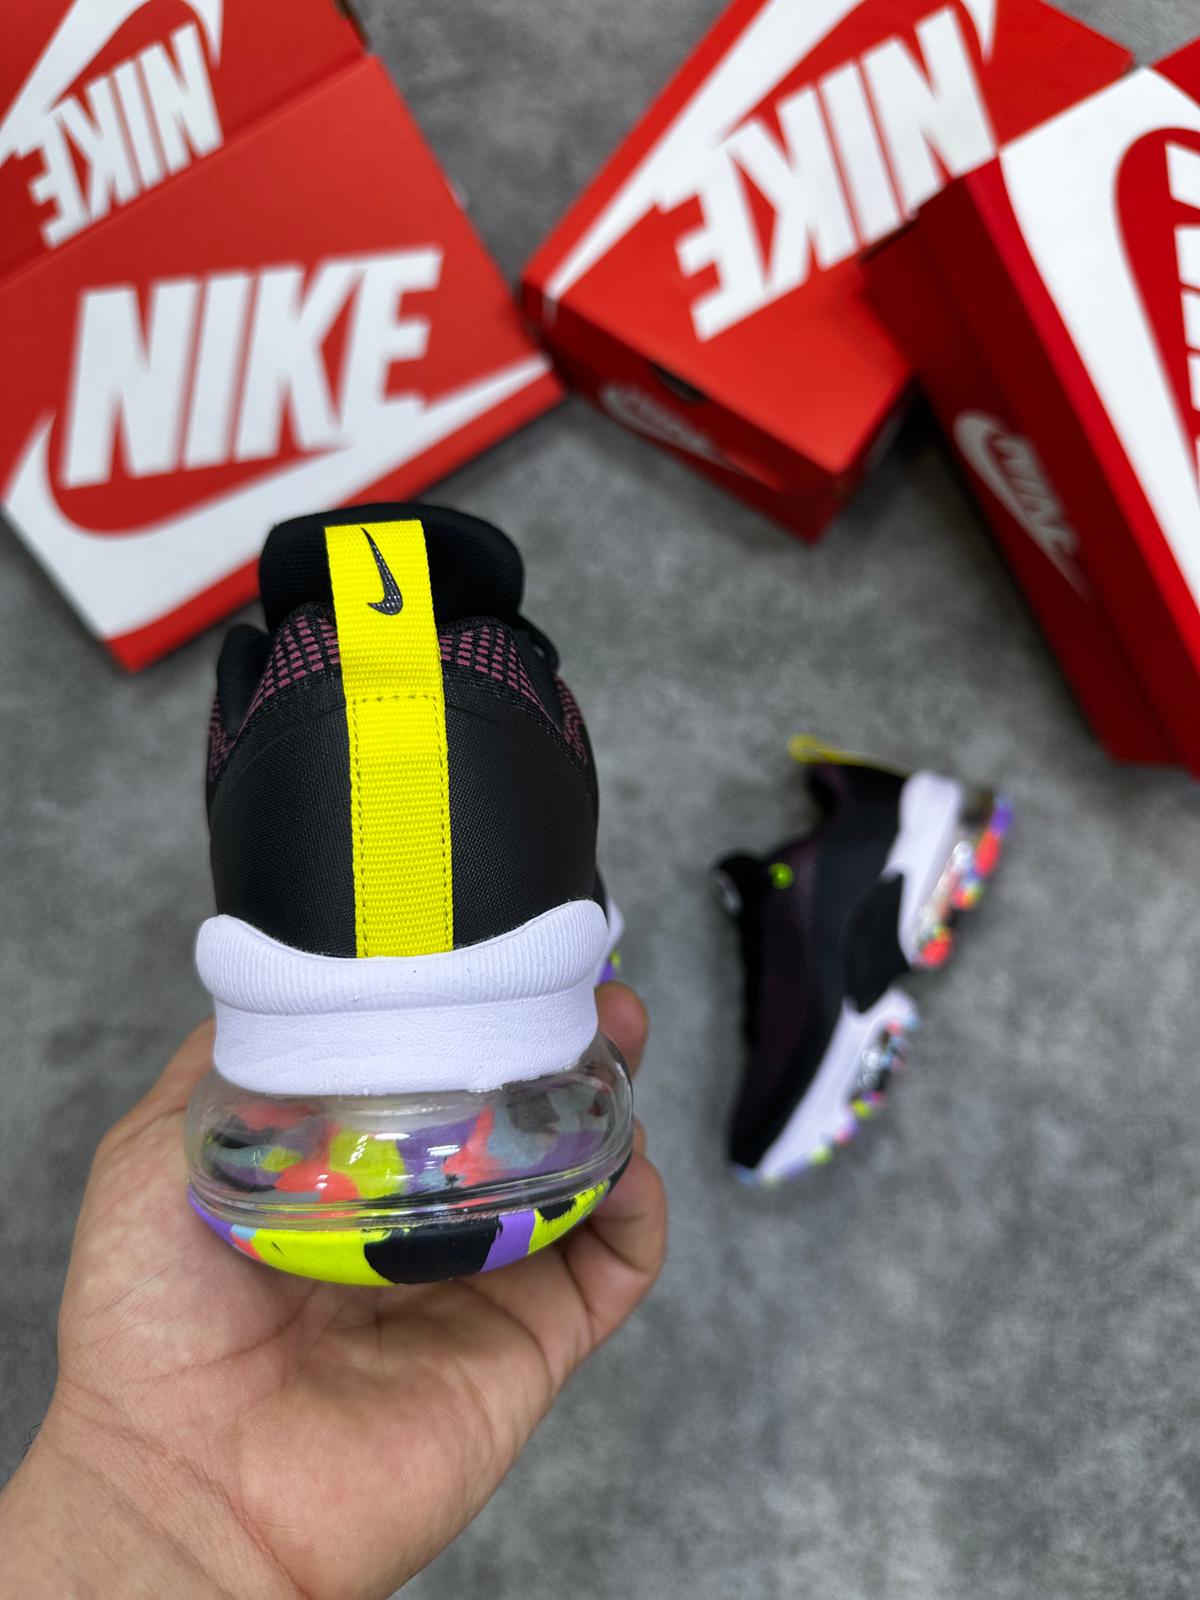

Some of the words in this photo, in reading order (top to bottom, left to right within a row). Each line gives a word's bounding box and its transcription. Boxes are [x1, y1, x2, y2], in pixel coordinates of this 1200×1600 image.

[16, 21, 224, 248] NIKE
[656, 6, 997, 343] NIKE
[61, 247, 442, 488] NIKE
